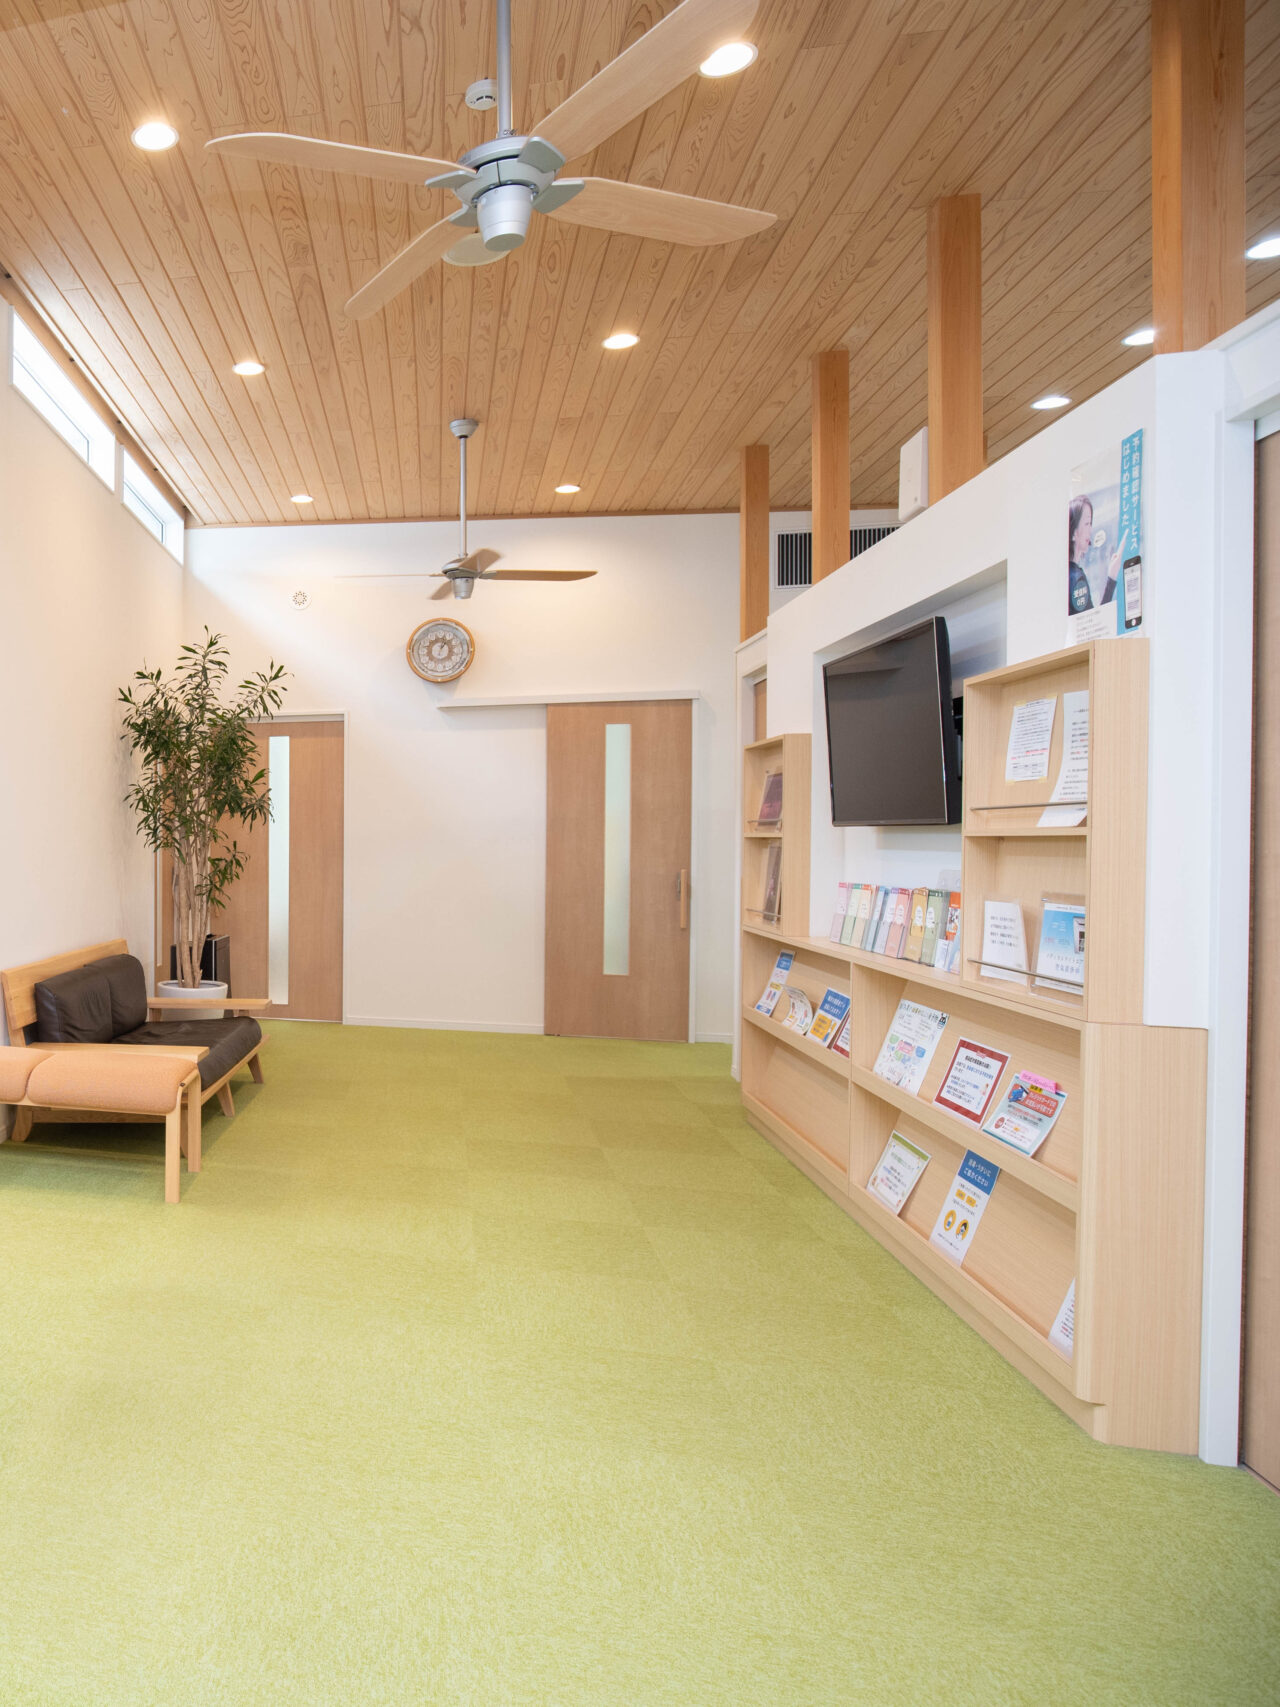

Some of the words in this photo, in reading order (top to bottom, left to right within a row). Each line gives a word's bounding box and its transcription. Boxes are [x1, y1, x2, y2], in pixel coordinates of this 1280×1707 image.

[1122, 443, 1130, 526] はじめました
[1130, 437, 1141, 551] 予約確認サービス
